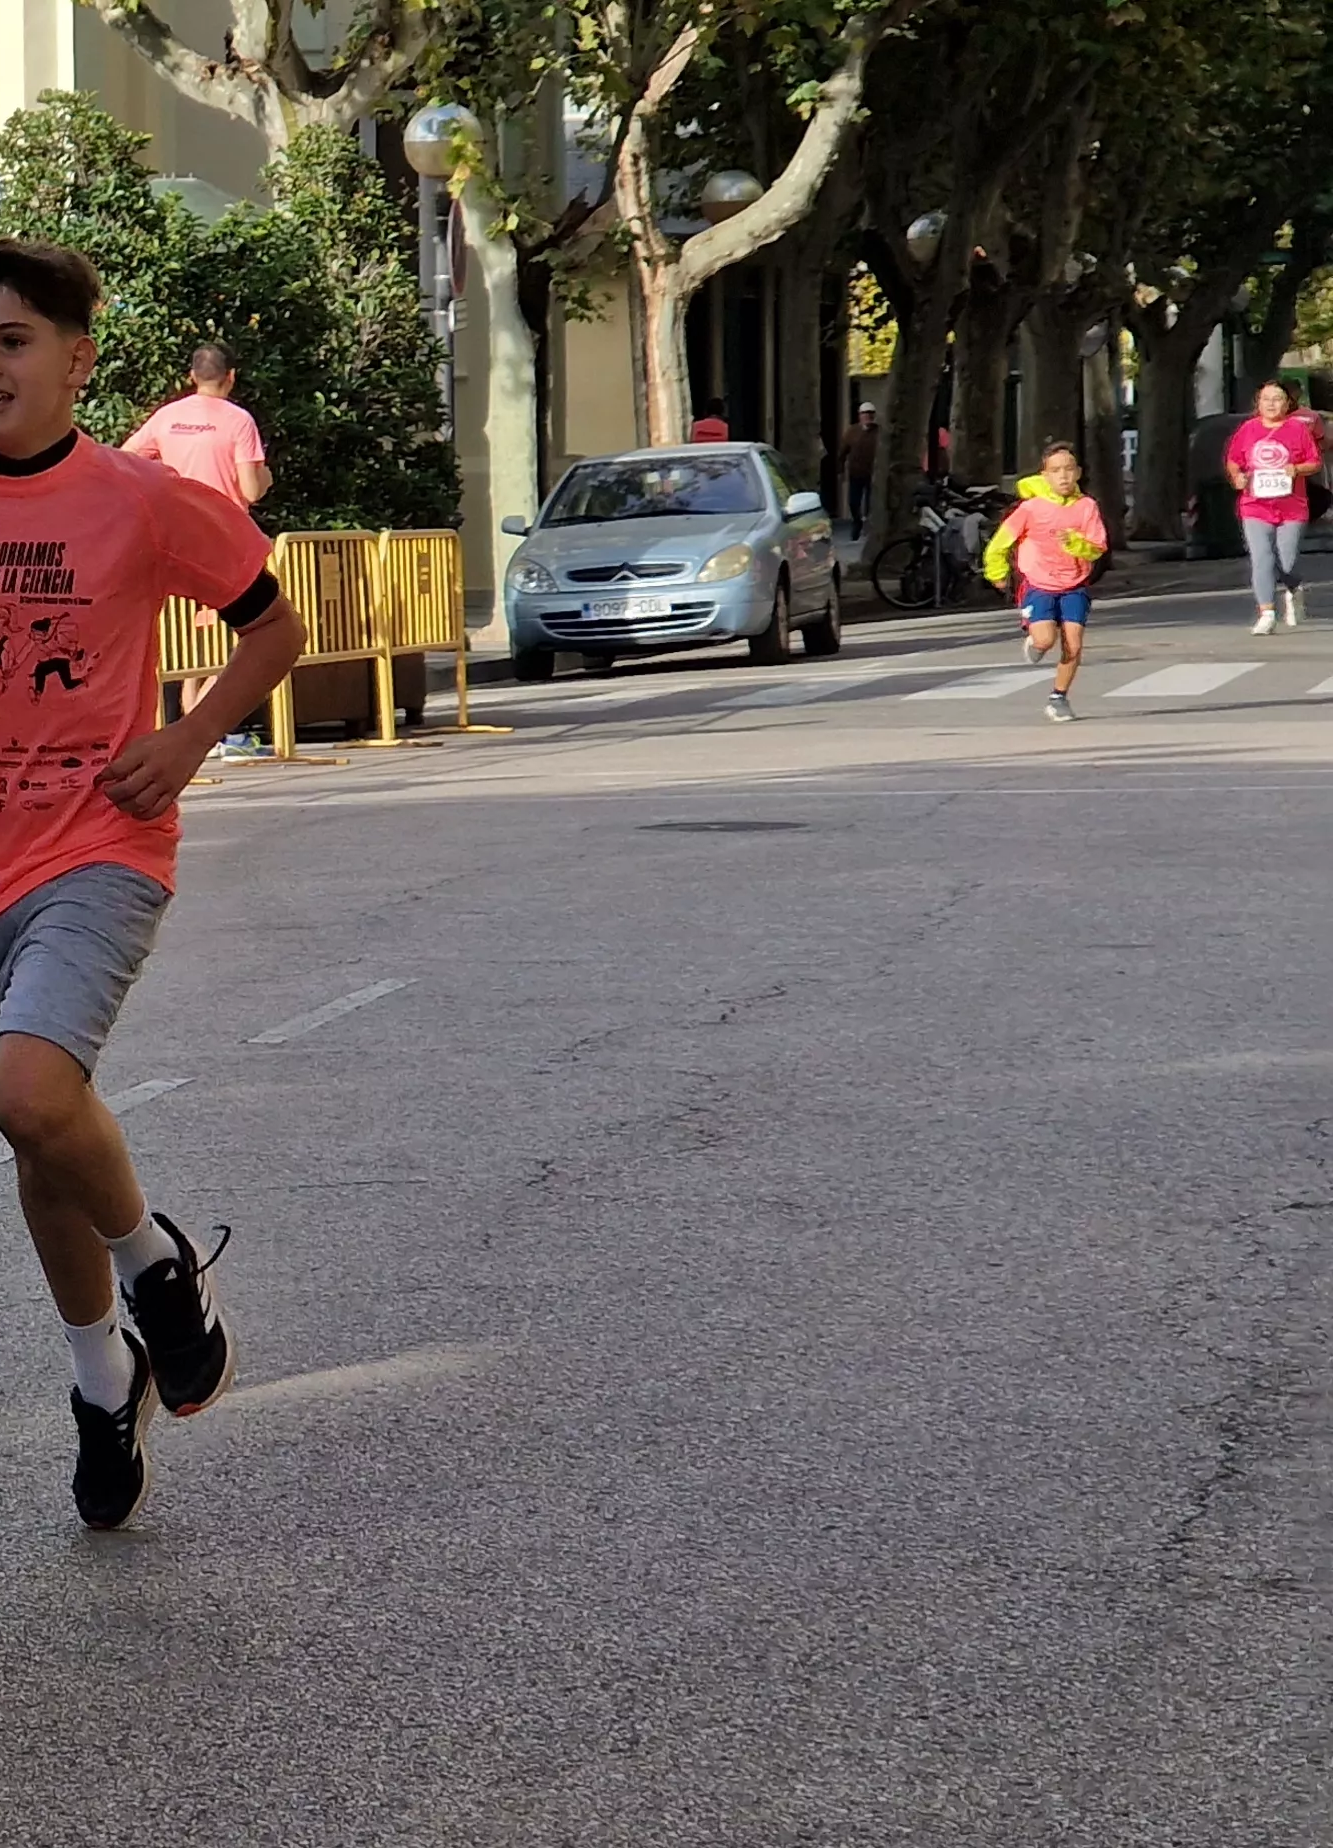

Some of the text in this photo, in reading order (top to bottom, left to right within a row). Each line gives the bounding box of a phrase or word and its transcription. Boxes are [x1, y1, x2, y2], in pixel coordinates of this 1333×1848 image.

[1, 567, 17, 594] LA
[19, 568, 75, 594] CIENCIA
[593, 601, 628, 616] 9097
